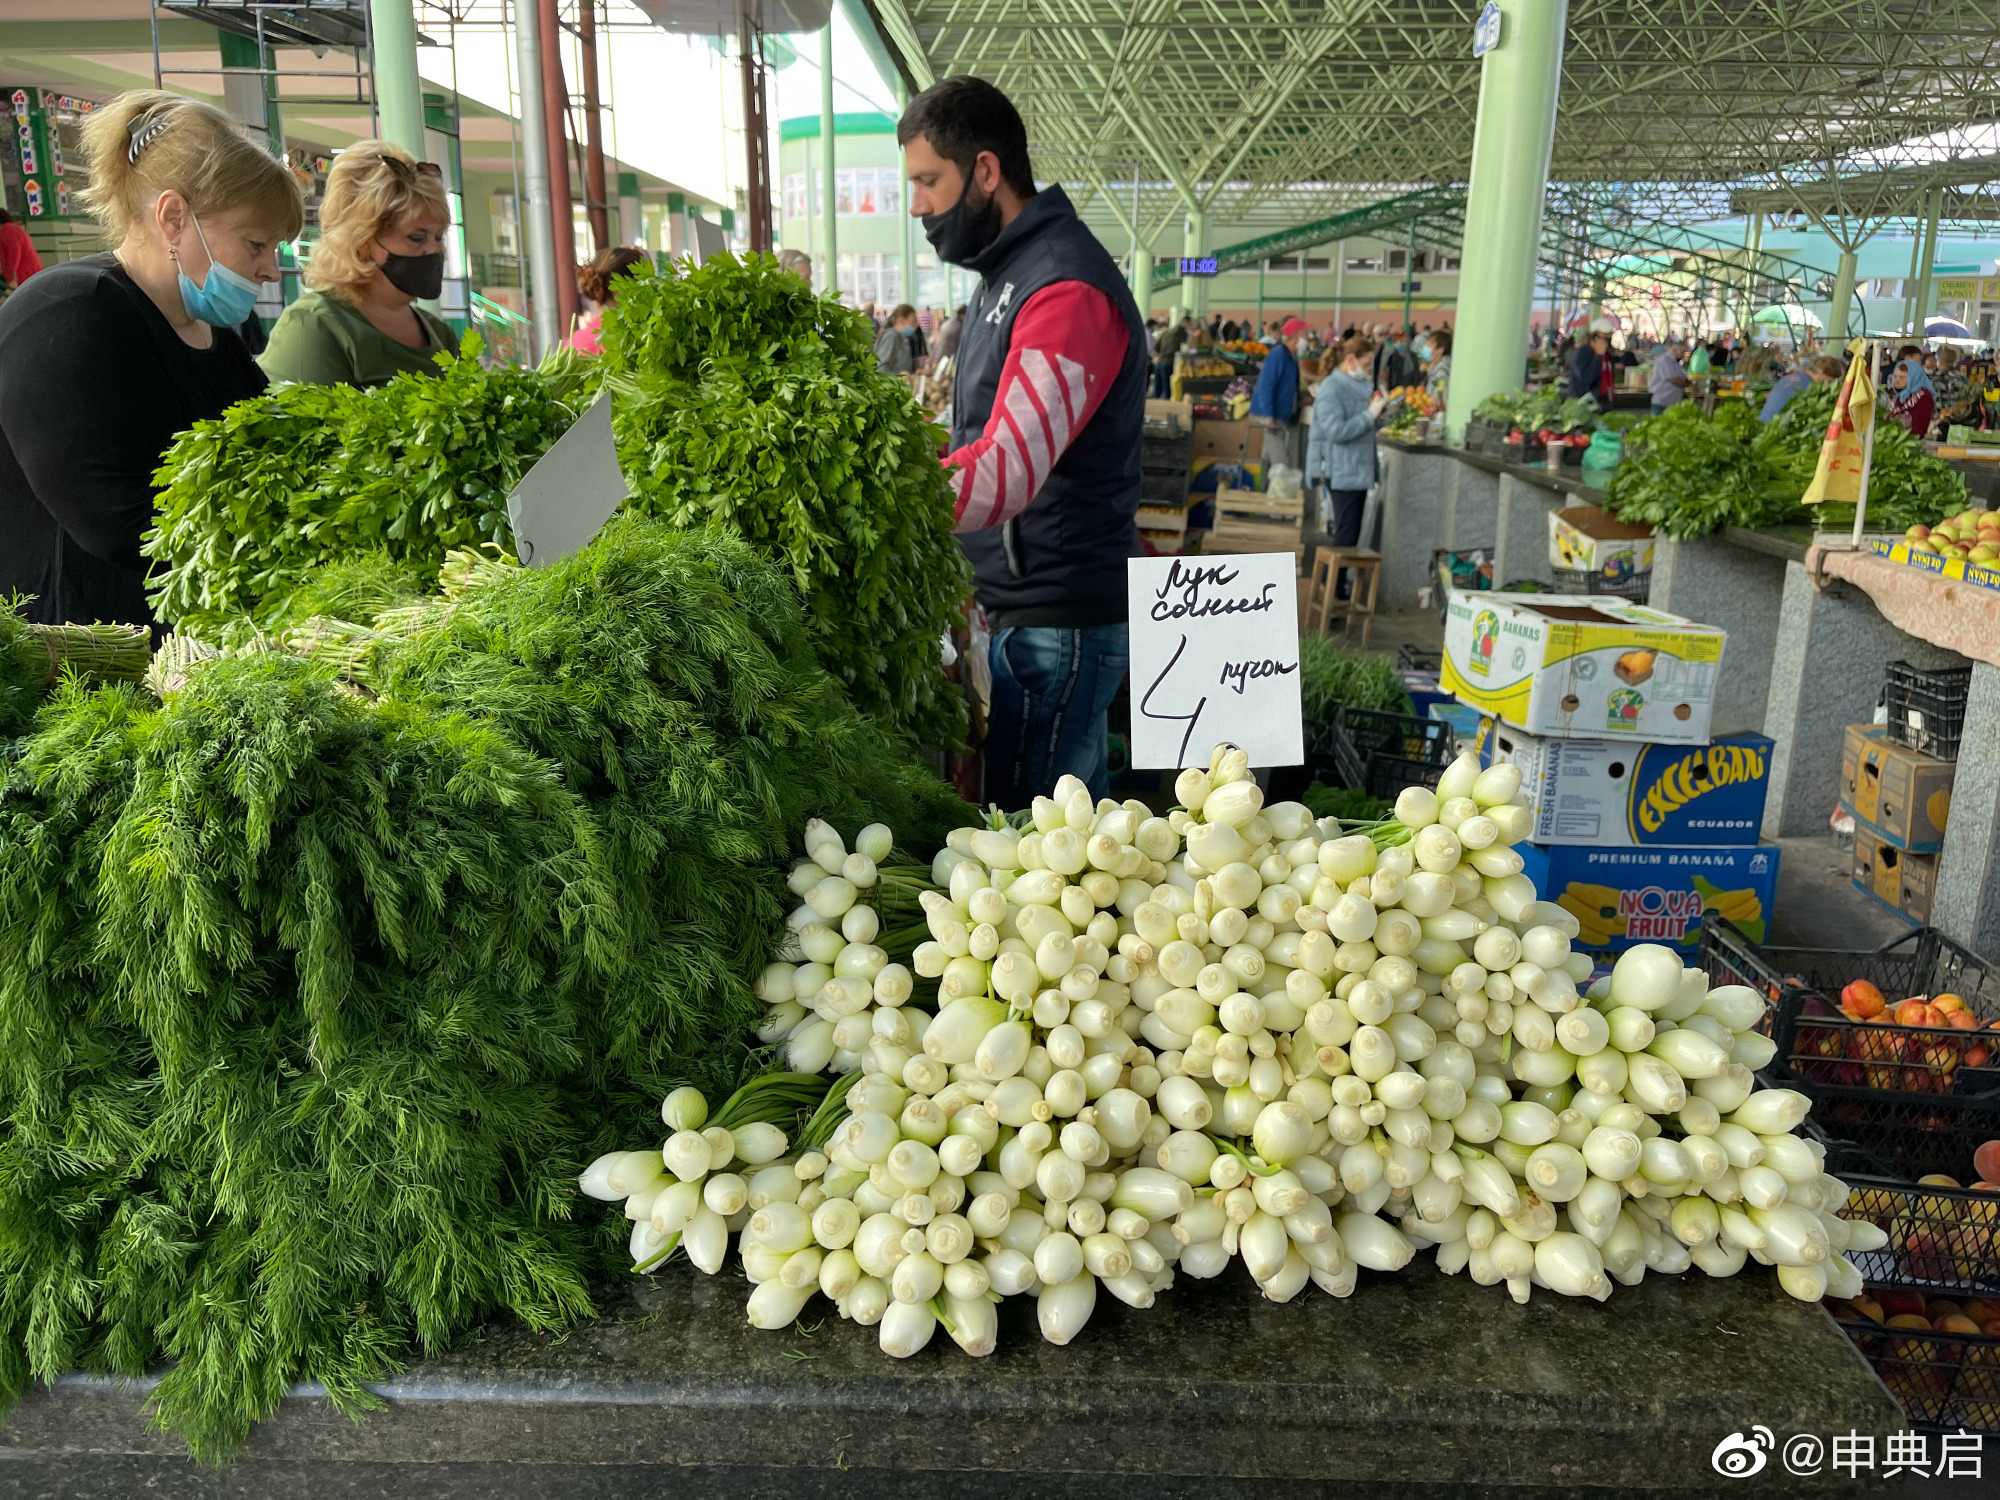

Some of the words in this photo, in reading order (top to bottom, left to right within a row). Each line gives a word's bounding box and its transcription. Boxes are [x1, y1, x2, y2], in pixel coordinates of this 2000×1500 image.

[1181, 257, 1218, 273] 11:02
[1156, 559, 1240, 607] Лук
[1503, 620, 1541, 641] BANANAS
[1634, 631, 1668, 641] PRODUCT
[1671, 633, 1679, 641] OF
[1682, 634, 1718, 644] COLOMBIA
[1220, 659, 1299, 694] пучок
[1140, 634, 1207, 769] 4
[1544, 742, 1562, 796] BANANAS
[1638, 744, 1764, 833] EXCELBAN
[1540, 798, 1555, 836] FRESH
[1688, 819, 1754, 828] ECUADOR
[1588, 853, 1662, 865] PREMIUM
[1668, 854, 1735, 867] BANANA
[1617, 885, 1704, 917] NOVA
[1625, 916, 1689, 940] FRUIT
